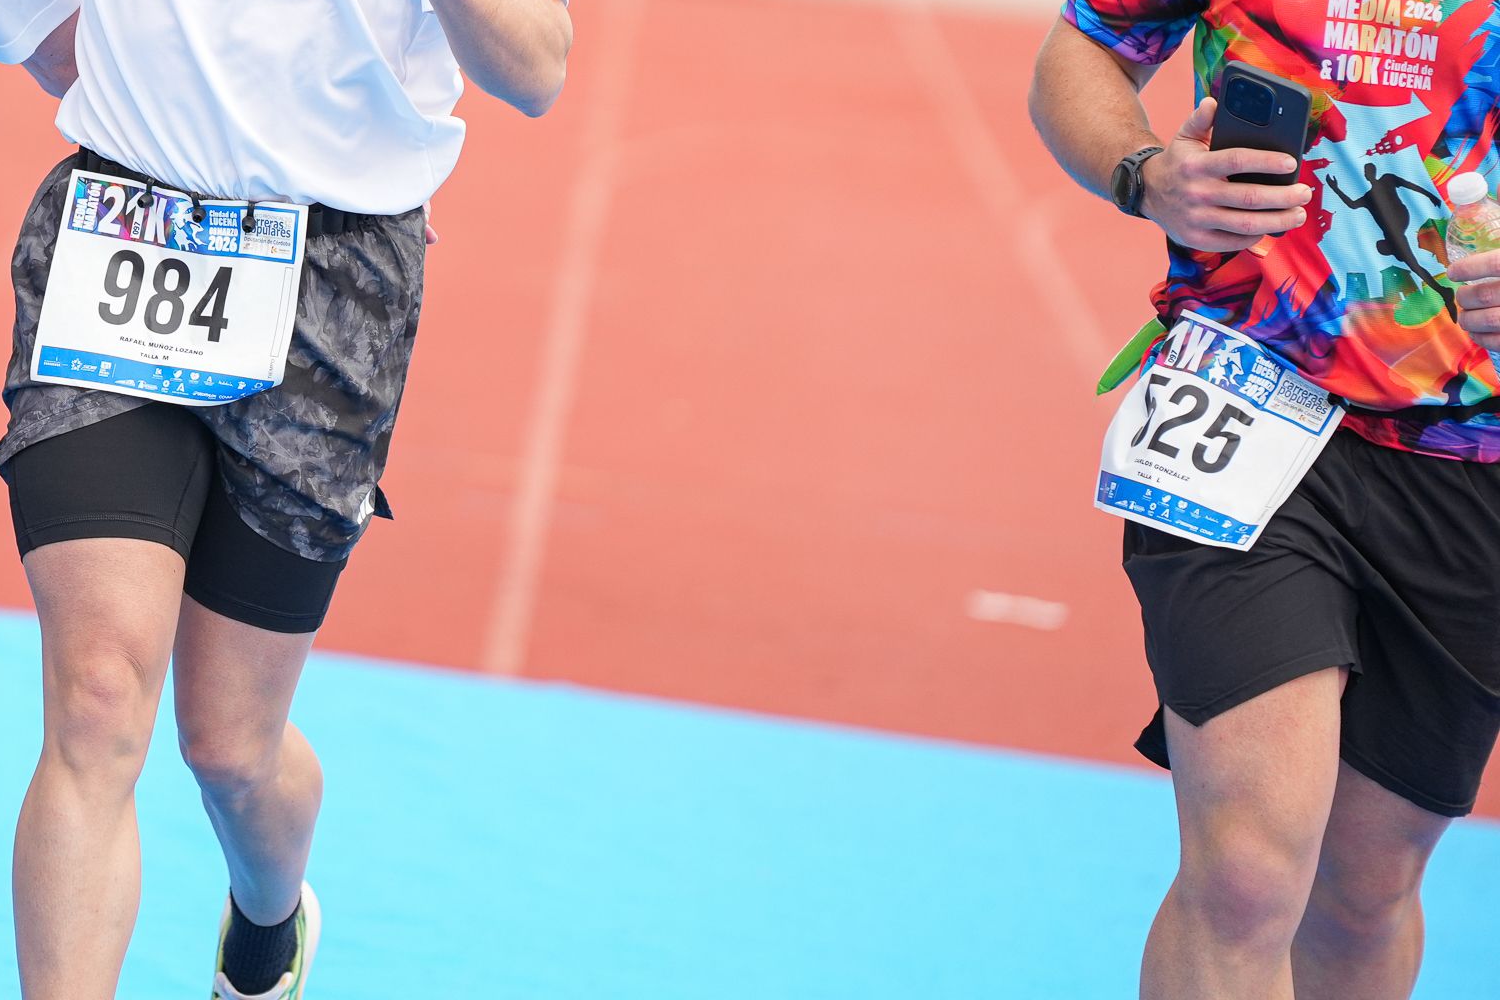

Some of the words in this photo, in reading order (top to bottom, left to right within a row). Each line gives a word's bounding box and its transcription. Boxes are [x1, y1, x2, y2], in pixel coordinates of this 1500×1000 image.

[1403, 0, 1443, 22] 2026
[1323, 21, 1439, 62] MARATÓN
[1320, 59, 1333, 81] &
[1336, 54, 1381, 85] 10K
[1383, 59, 1419, 75] Ciudad
[1420, 64, 1434, 77] de
[1382, 72, 1432, 91] LUCENA
[72, 199, 88, 229] MEDIA
[83, 182, 102, 231] MARATÓN
[98, 186, 167, 245] 21K
[209, 210, 229, 218] Ciudad
[209, 218, 238, 227] LUCENA
[245, 225, 291, 238] opulares
[255, 218, 284, 229] rreras
[208, 236, 238, 252] 2026
[98, 249, 233, 343] 984
[120, 336, 146, 347] RAFAEL
[175, 347, 203, 356] LOZANO
[140, 352, 159, 360] TALLA
[1251, 362, 1278, 383] LUCENA
[1238, 381, 1269, 405] 2026
[1277, 387, 1328, 415] populares
[1282, 379, 1324, 405] carreras
[1131, 373, 1255, 474] 525
